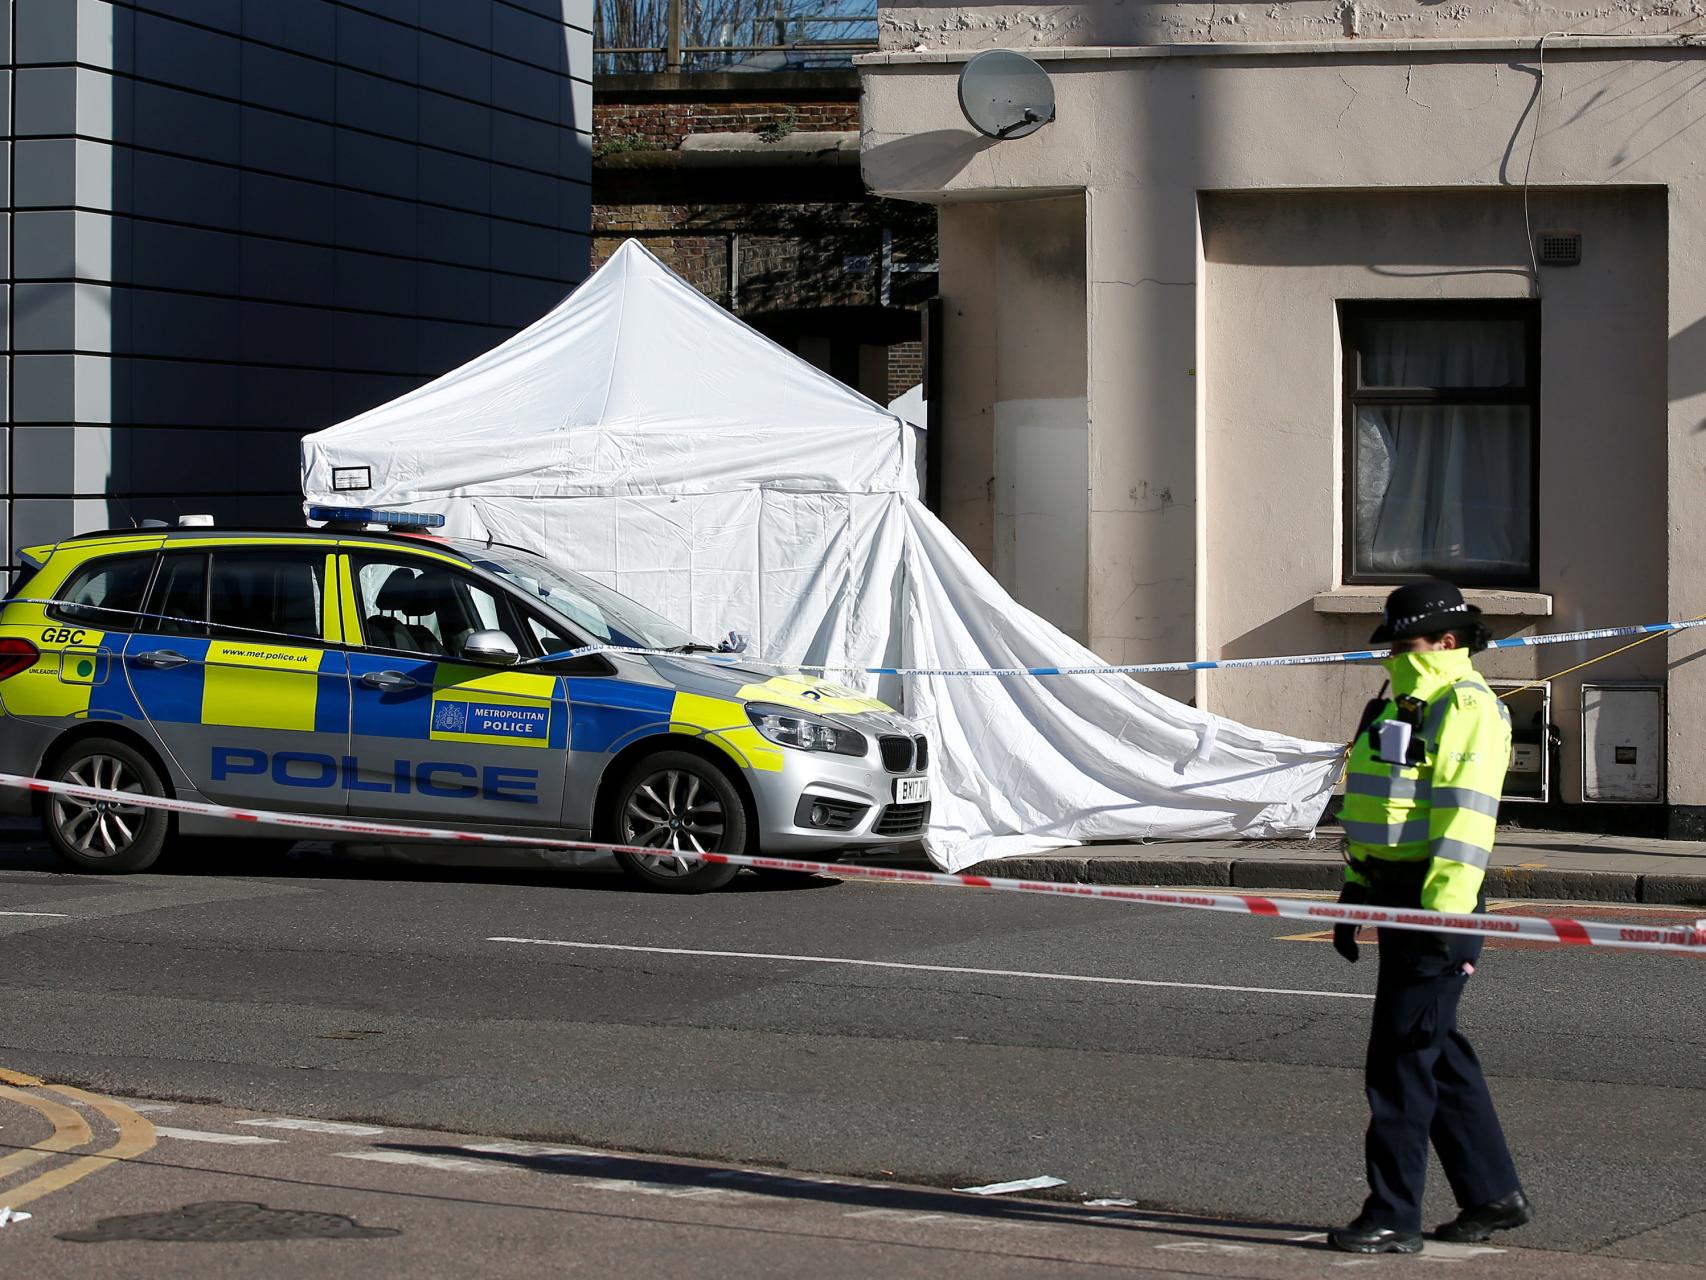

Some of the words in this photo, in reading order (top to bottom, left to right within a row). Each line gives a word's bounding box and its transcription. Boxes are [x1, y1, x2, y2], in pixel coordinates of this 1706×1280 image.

[41, 628, 86, 644] GBC
[222, 647, 309, 663] www.met.police.uk
[474, 708, 544, 721] METROPOLITAN
[483, 720, 533, 733] POLICE
[211, 747, 538, 804] POLICE
